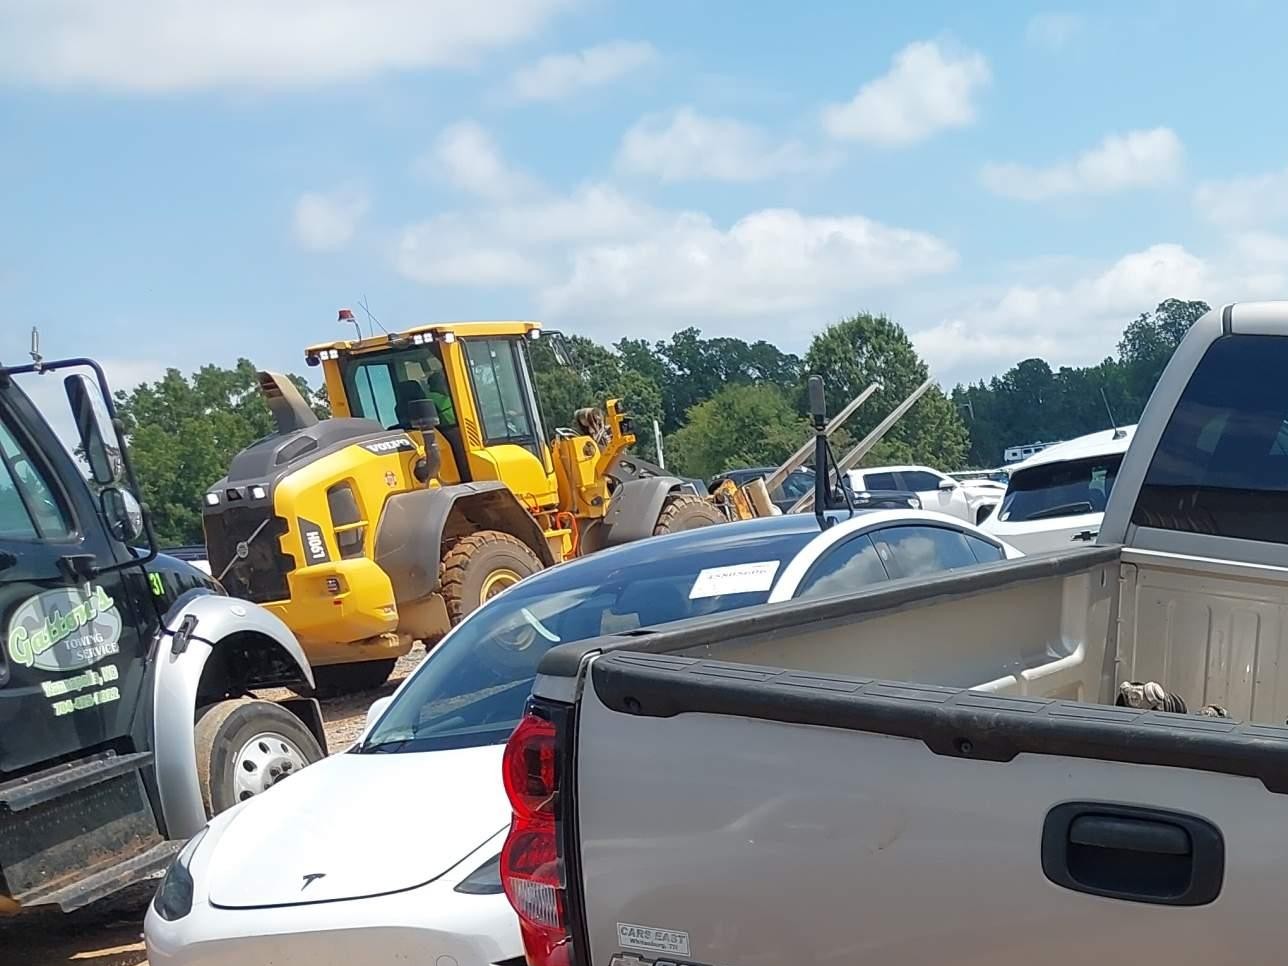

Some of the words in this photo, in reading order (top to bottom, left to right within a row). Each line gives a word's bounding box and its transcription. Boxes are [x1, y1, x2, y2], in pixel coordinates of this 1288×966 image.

[366, 438, 411, 452] VOLVO
[149, 573, 165, 595] 31
[65, 631, 104, 650] TOWING
[77, 642, 118, 660] SERVICE
[620, 926, 652, 939] CARS
[655, 931, 686, 945] EAST
